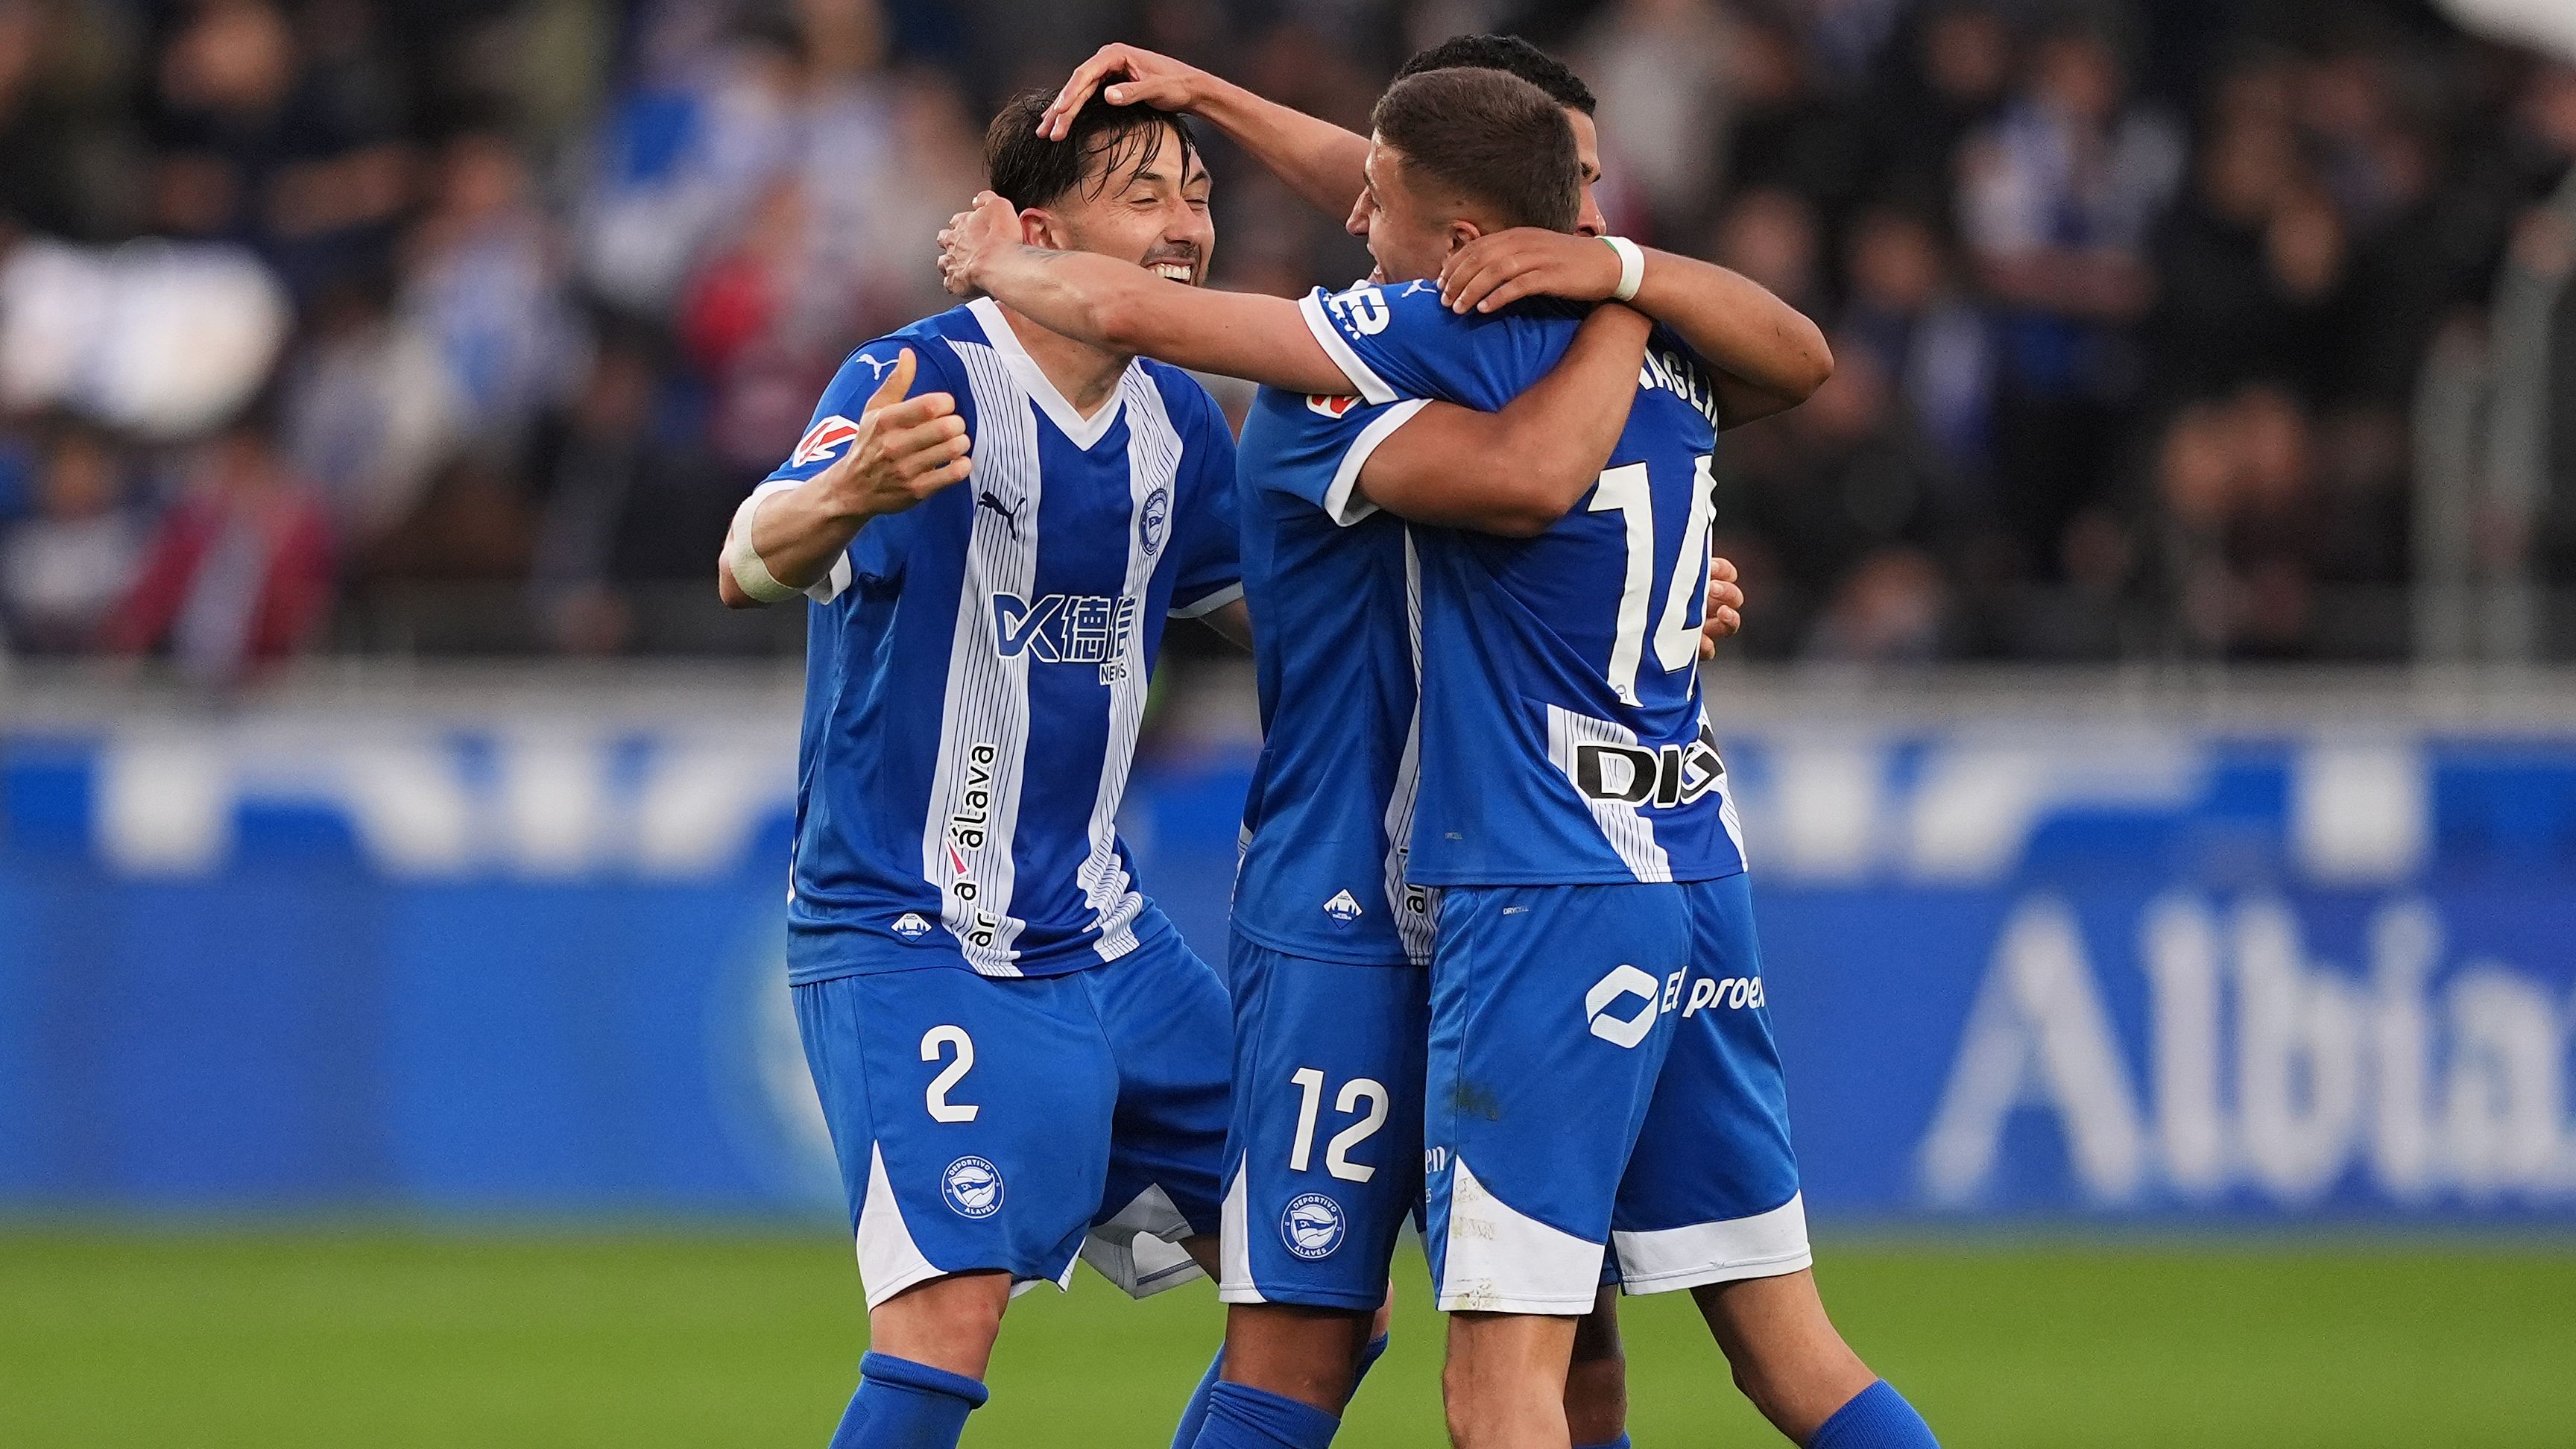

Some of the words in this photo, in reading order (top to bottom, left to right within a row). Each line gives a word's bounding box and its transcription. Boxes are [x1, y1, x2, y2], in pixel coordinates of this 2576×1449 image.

[1588, 455, 1717, 707] 14
[921, 1024, 979, 1123] 2
[948, 1159, 991, 1176] DEPORTIVO
[1289, 1067, 1389, 1184] 12
[1292, 1196, 1337, 1213] DEPORTIVO
